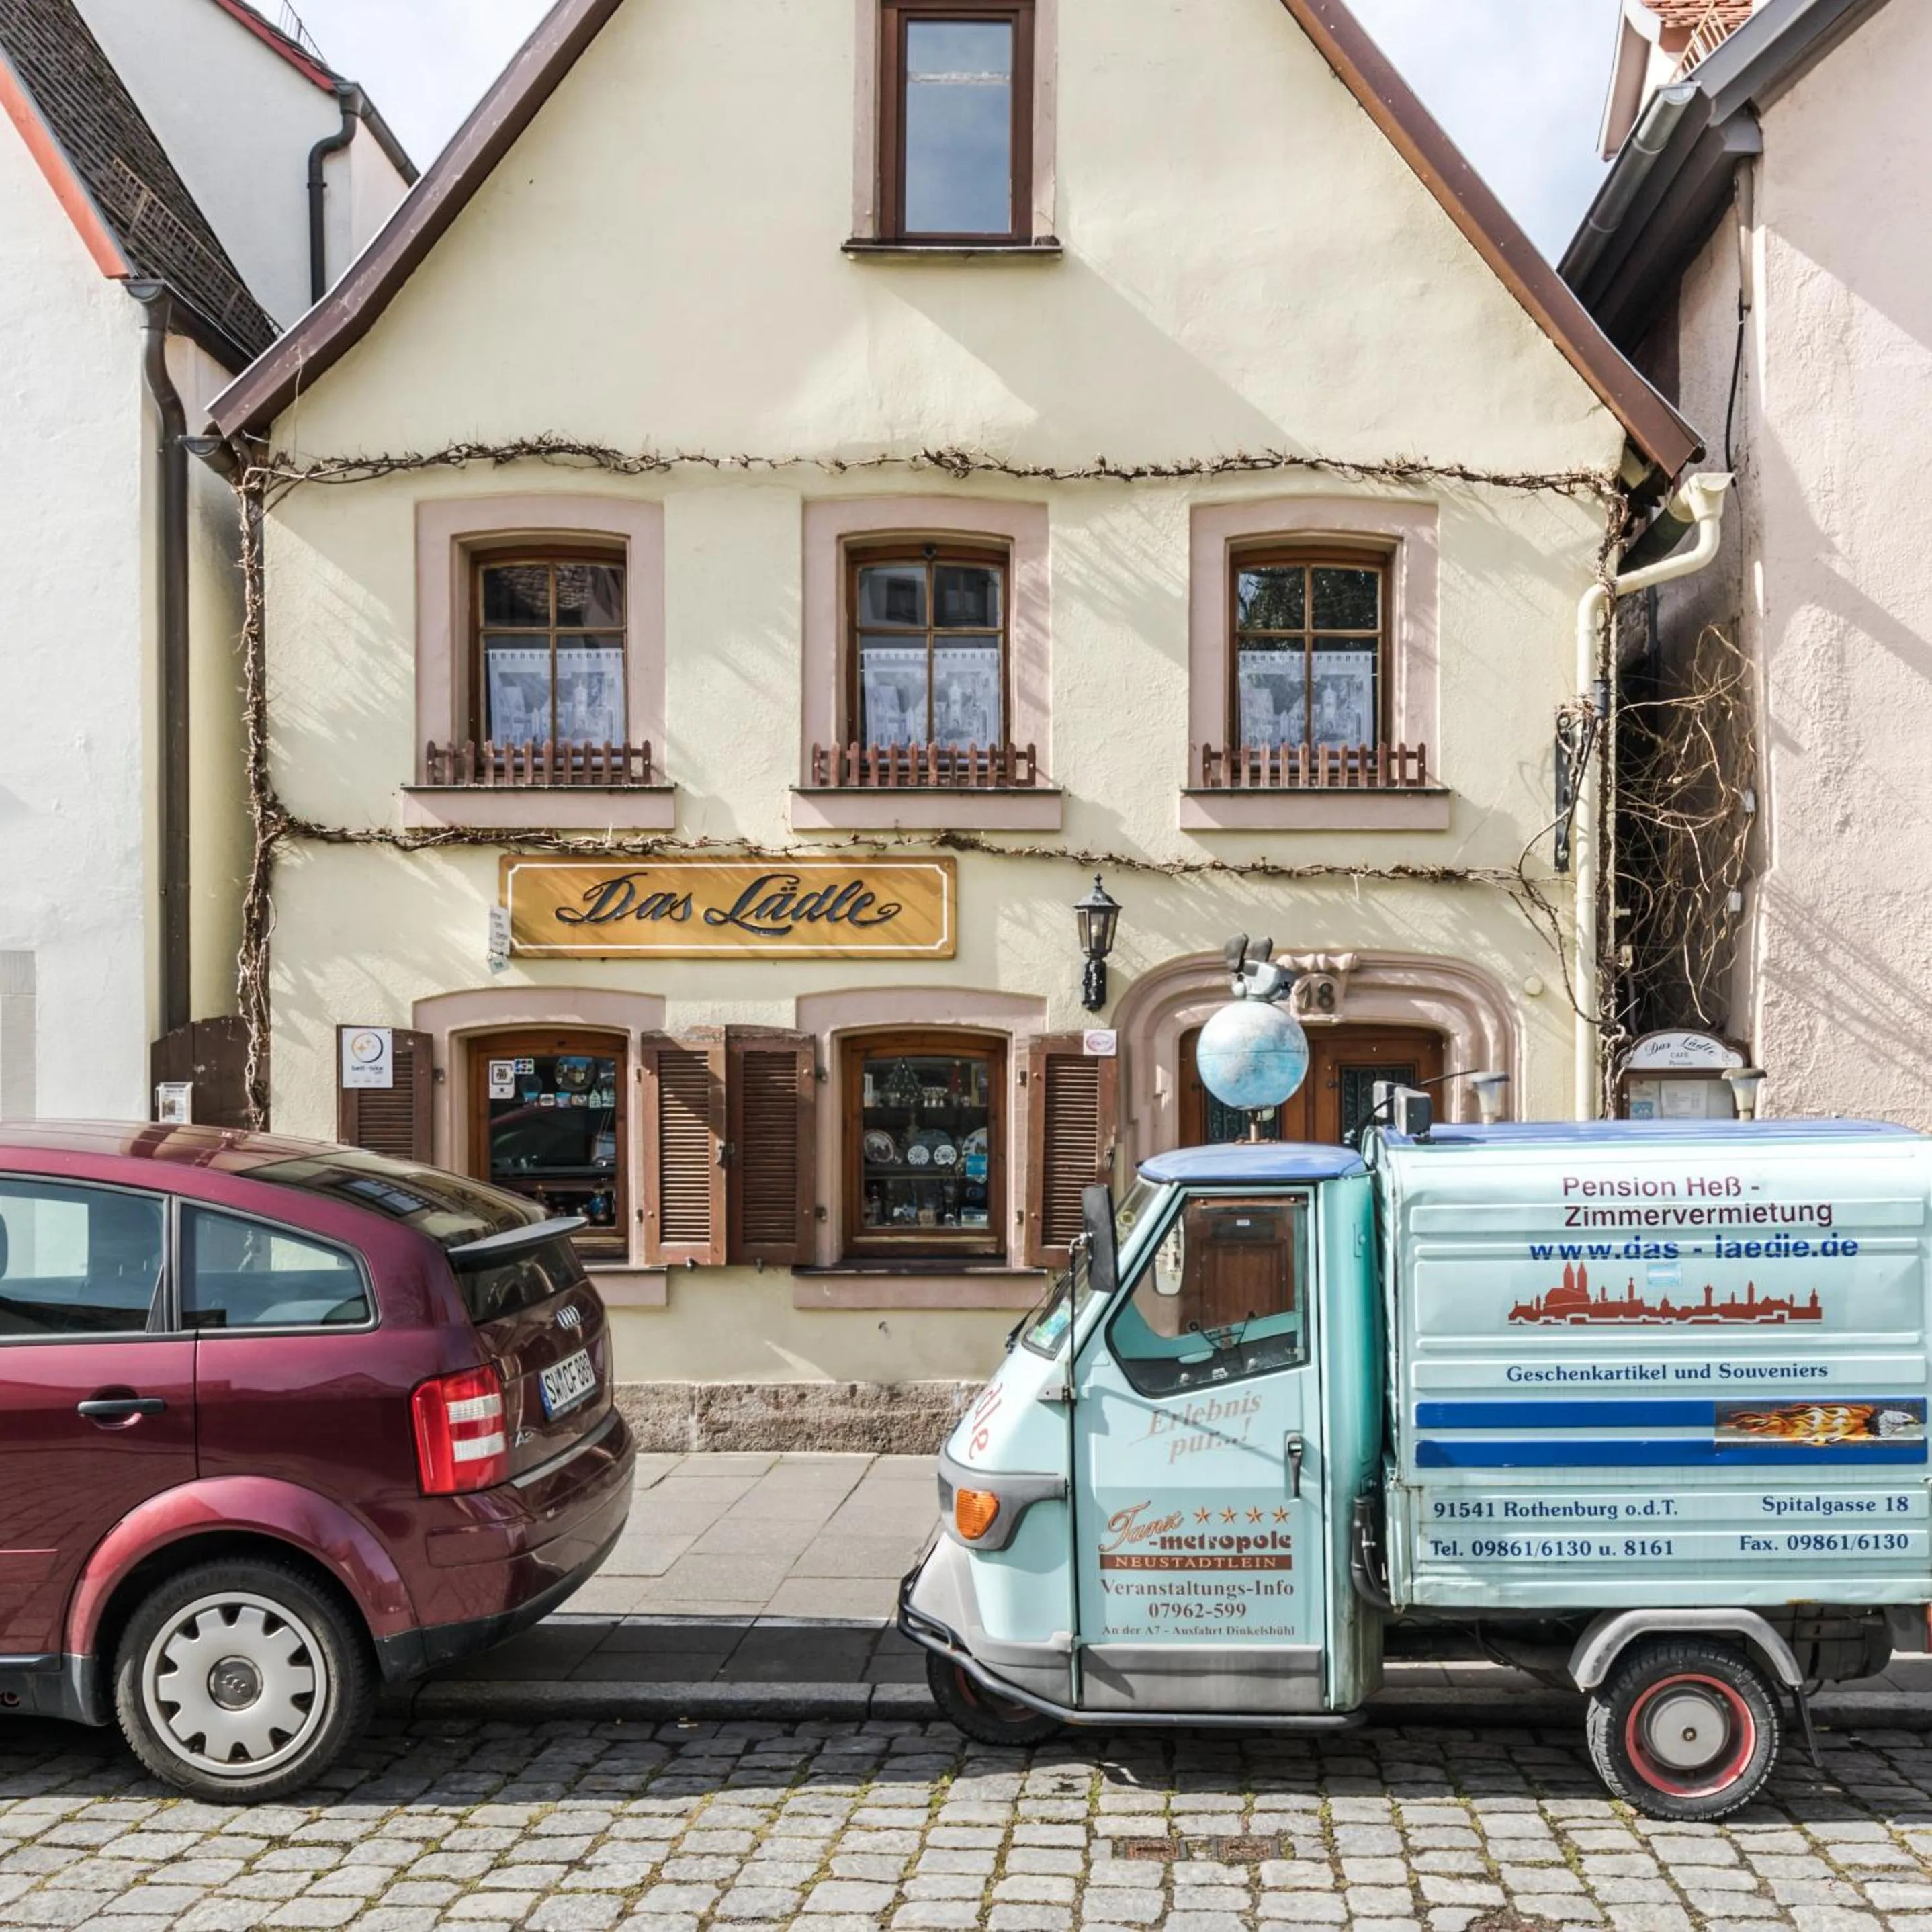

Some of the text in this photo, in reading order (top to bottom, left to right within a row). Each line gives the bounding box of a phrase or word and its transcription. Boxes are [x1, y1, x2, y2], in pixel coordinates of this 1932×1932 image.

[555, 872, 903, 936] Das Lädle
[1295, 980, 1335, 1010] 18
[1645, 1042, 1671, 1057] Das
[1563, 1177, 1677, 1197] Pension
[1688, 1176, 1741, 1197] Heß
[1564, 1202, 1833, 1227] Zimmervermietung
[1507, 1363, 1829, 1382] Geschenkartikel und Souveniers
[1146, 1391, 1262, 1438] Erlebnis
[1434, 1500, 1678, 1519] 91541 Rothenburg o.d.T.
[1762, 1495, 1909, 1516] Spitalgasse 18
[1430, 1540, 1674, 1557] Tel. 09861/6130 u. 8161
[1739, 1534, 1909, 1552] Fax. 09861/6130
[1115, 1556, 1276, 1568] NEUSTÄDTLEIN
[1100, 1579, 1294, 1599] Veranstaltungs-Info
[1149, 1602, 1247, 1618] 07962-599
[1102, 1626, 1118, 1635] An
[1123, 1625, 1141, 1635] der
[1145, 1626, 1161, 1635] A7
